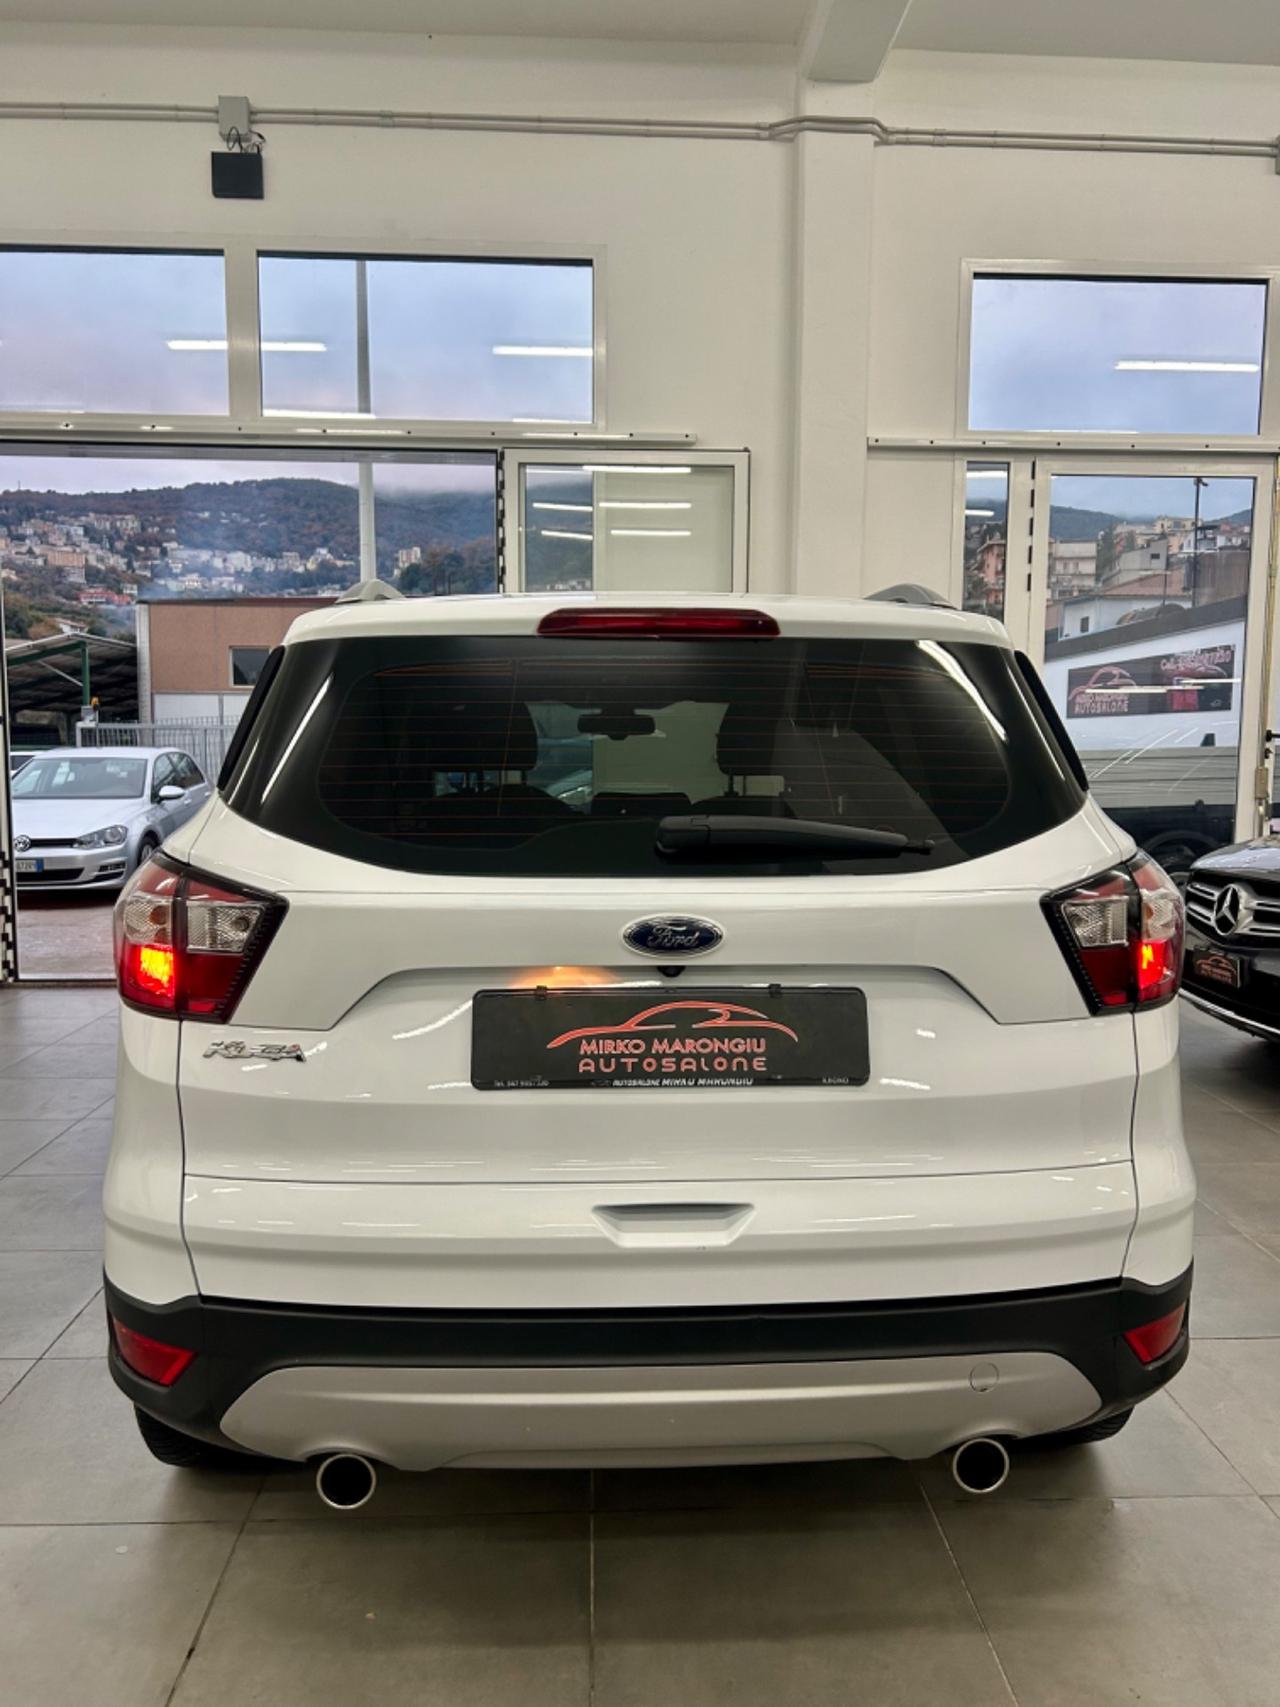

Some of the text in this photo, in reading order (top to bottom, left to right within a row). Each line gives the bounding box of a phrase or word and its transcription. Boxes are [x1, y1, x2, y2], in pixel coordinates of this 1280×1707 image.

[647, 926, 700, 947] Ford
[579, 1037, 766, 1055] MIRKO MARONGIU
[578, 1057, 768, 1073] AUTOSALONE
